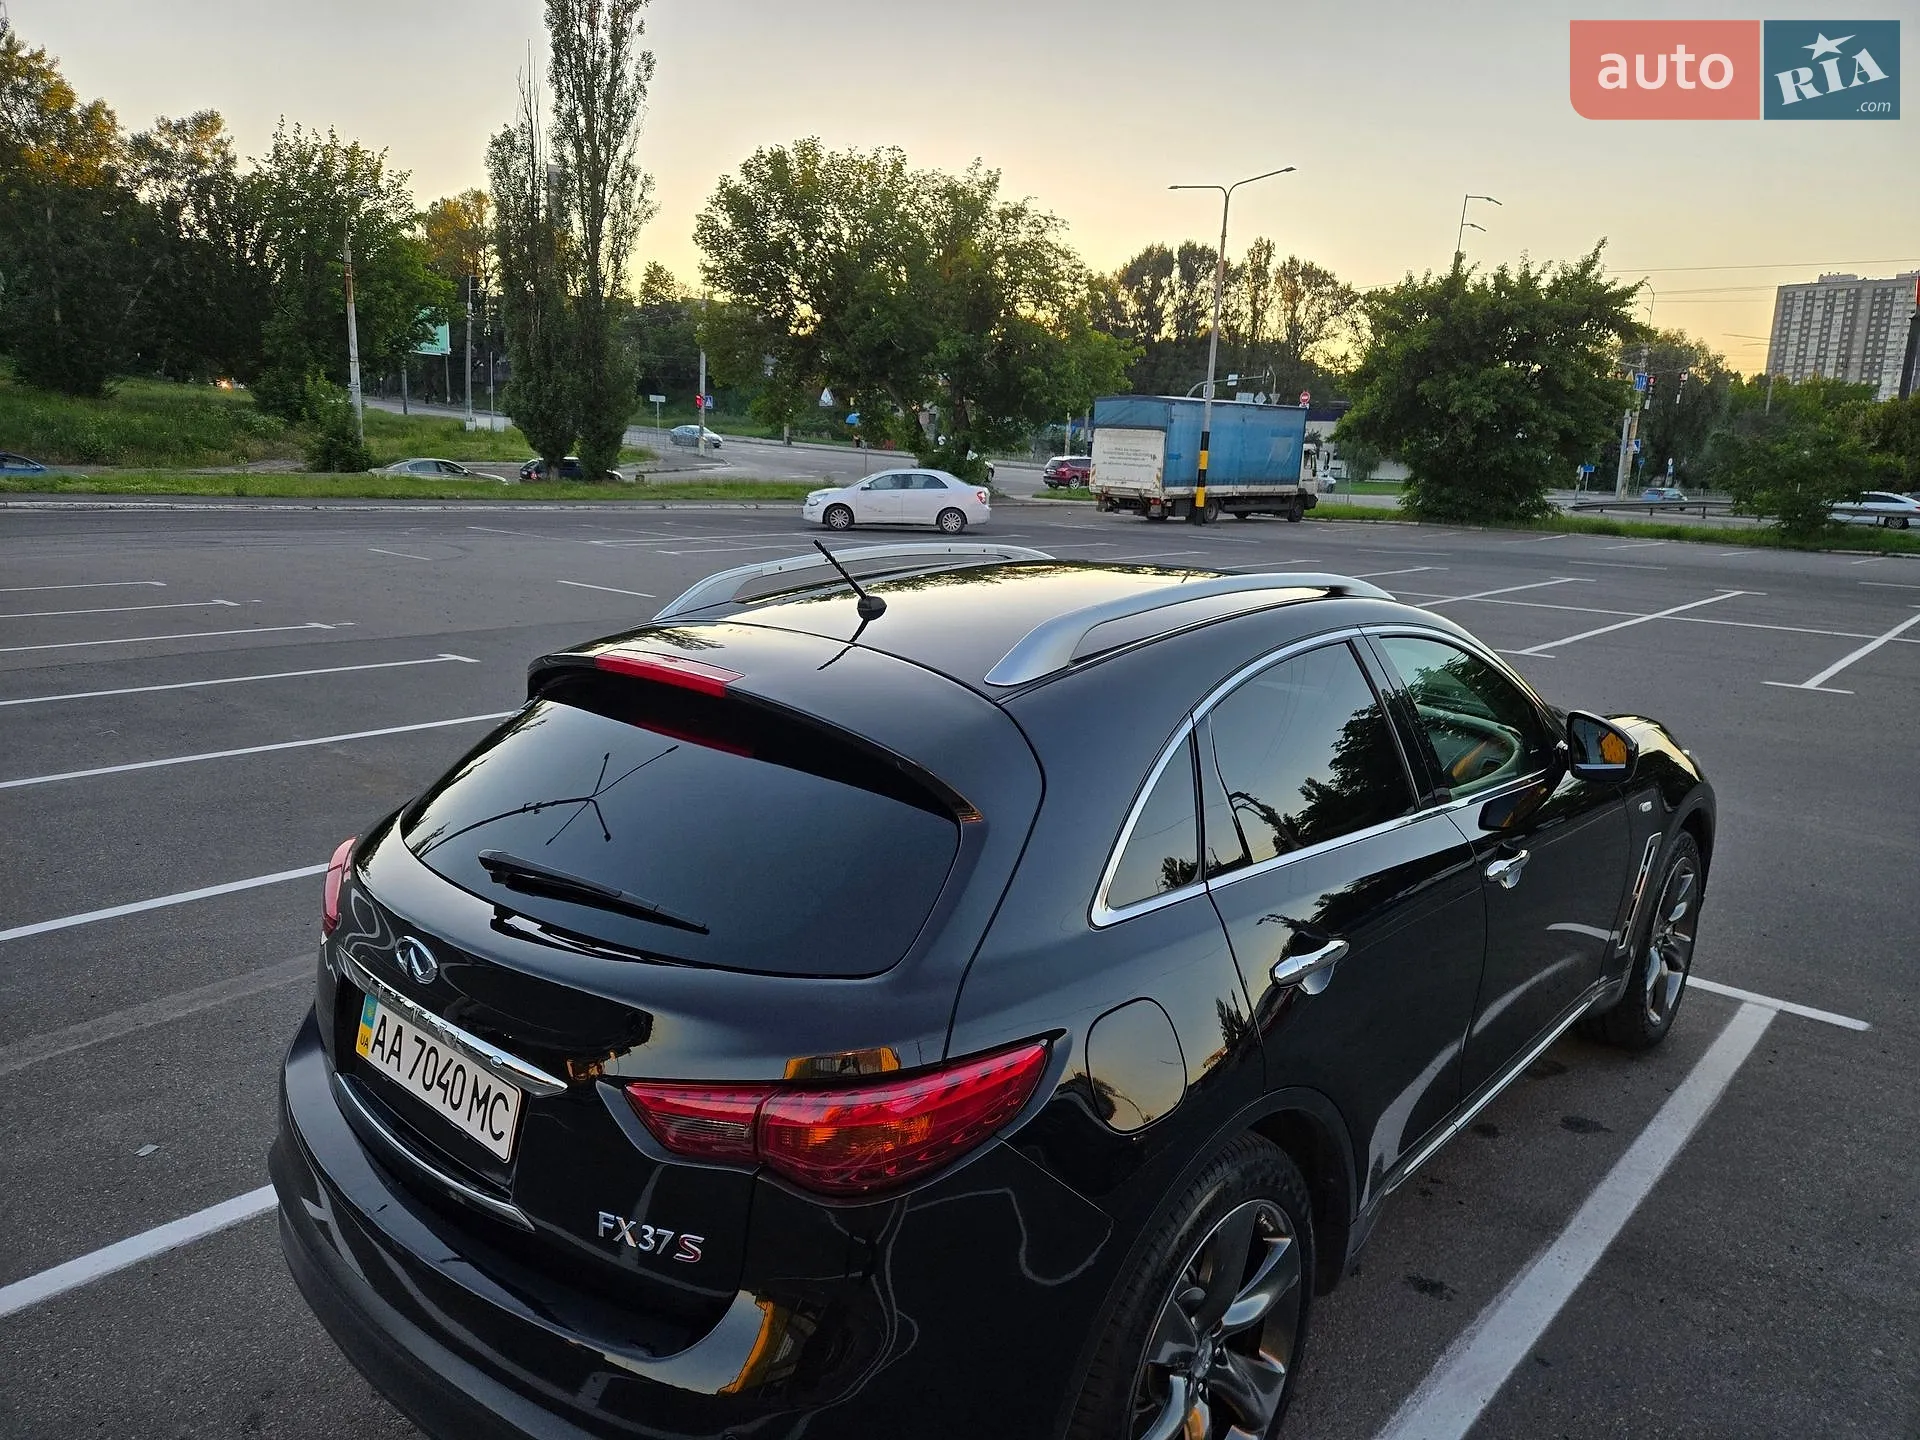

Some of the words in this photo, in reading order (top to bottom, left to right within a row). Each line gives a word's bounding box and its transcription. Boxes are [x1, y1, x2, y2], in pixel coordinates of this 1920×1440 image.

[360, 1033, 369, 1050] UA
[371, 1014, 401, 1072] AA
[408, 1037, 467, 1111] 7040
[467, 1075, 509, 1142] MC
[598, 1211, 675, 1255] FX37
